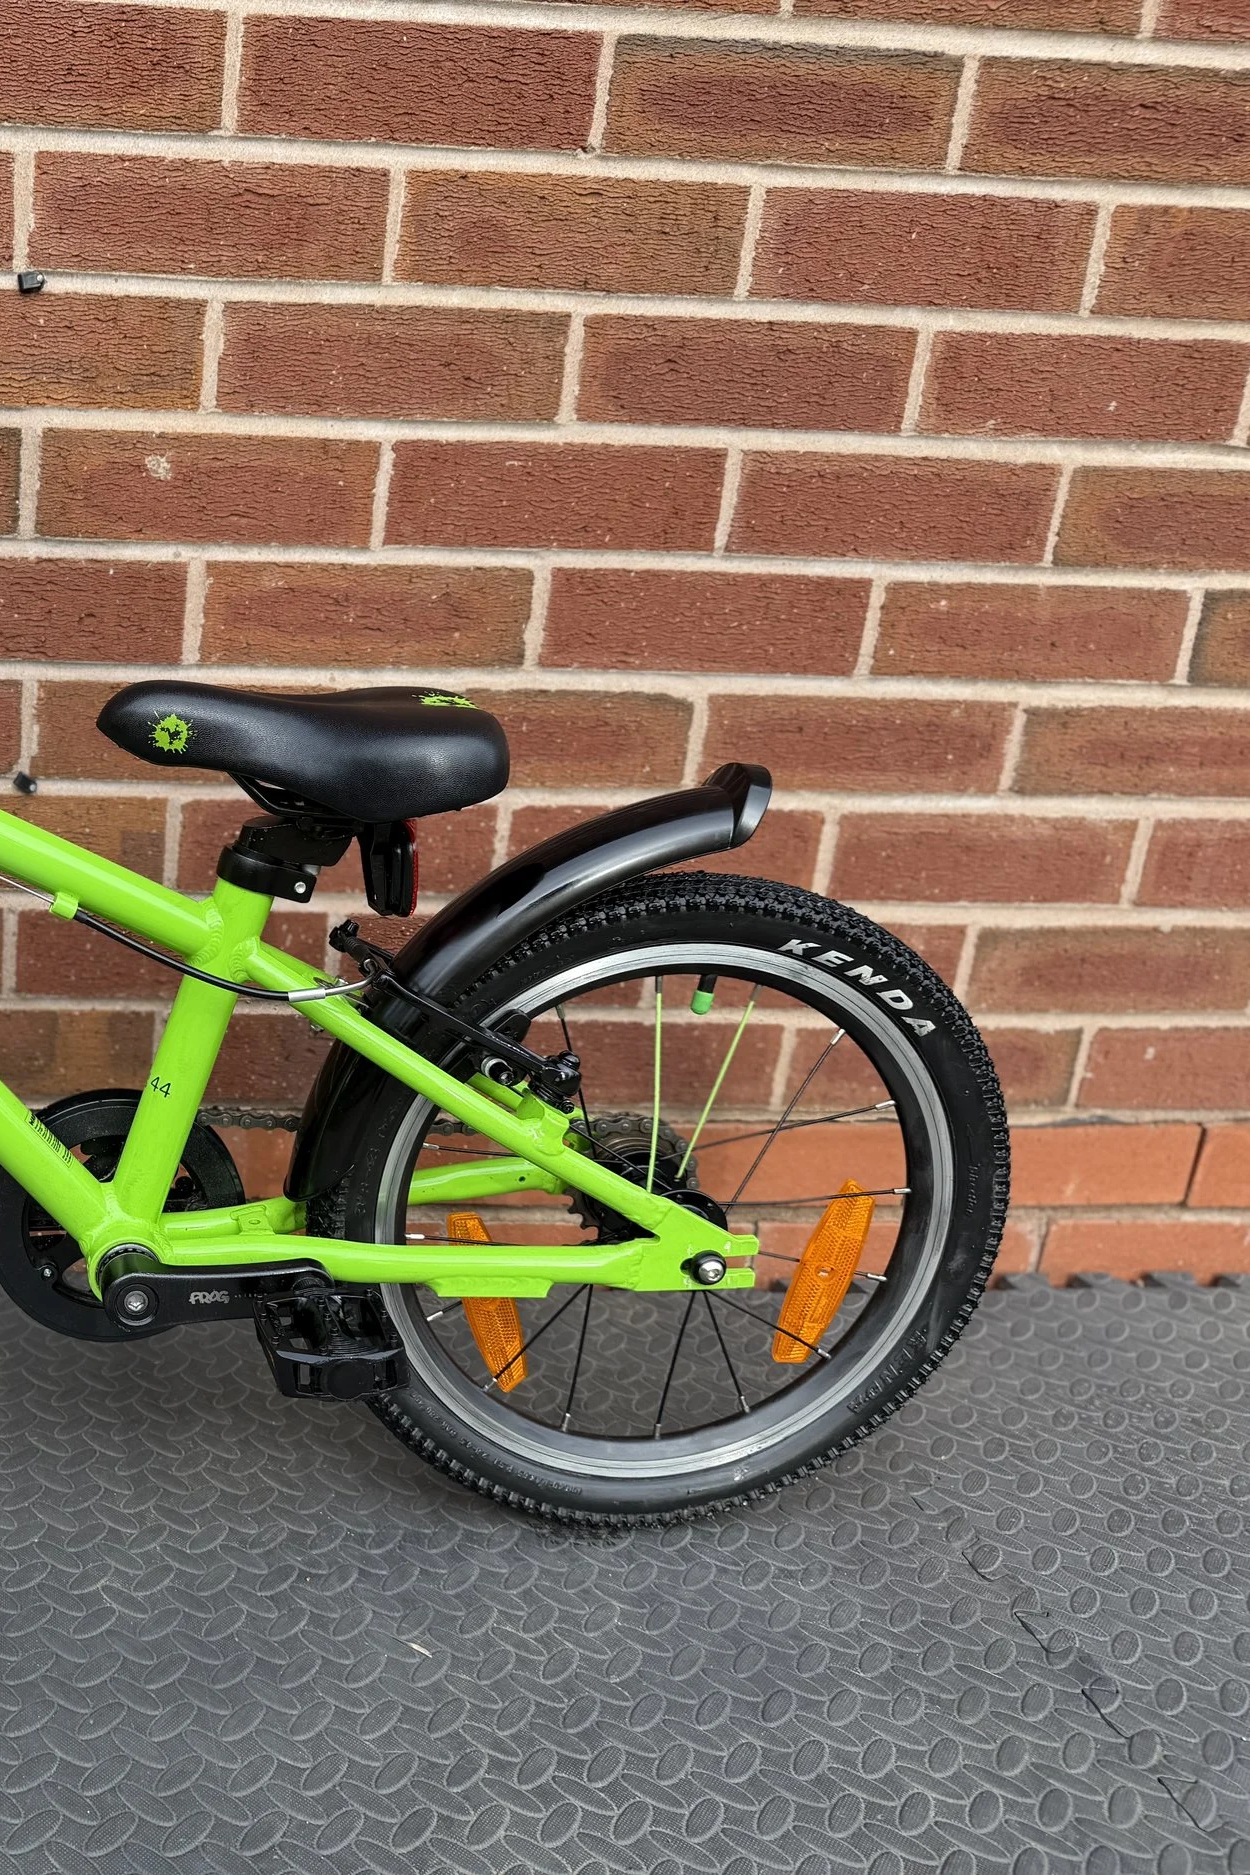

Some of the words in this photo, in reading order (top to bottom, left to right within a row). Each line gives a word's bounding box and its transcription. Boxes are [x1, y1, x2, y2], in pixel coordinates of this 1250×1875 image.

[777, 939, 937, 1037] KENDA
[150, 1076, 171, 1098] 44
[188, 1289, 230, 1305] FROG
